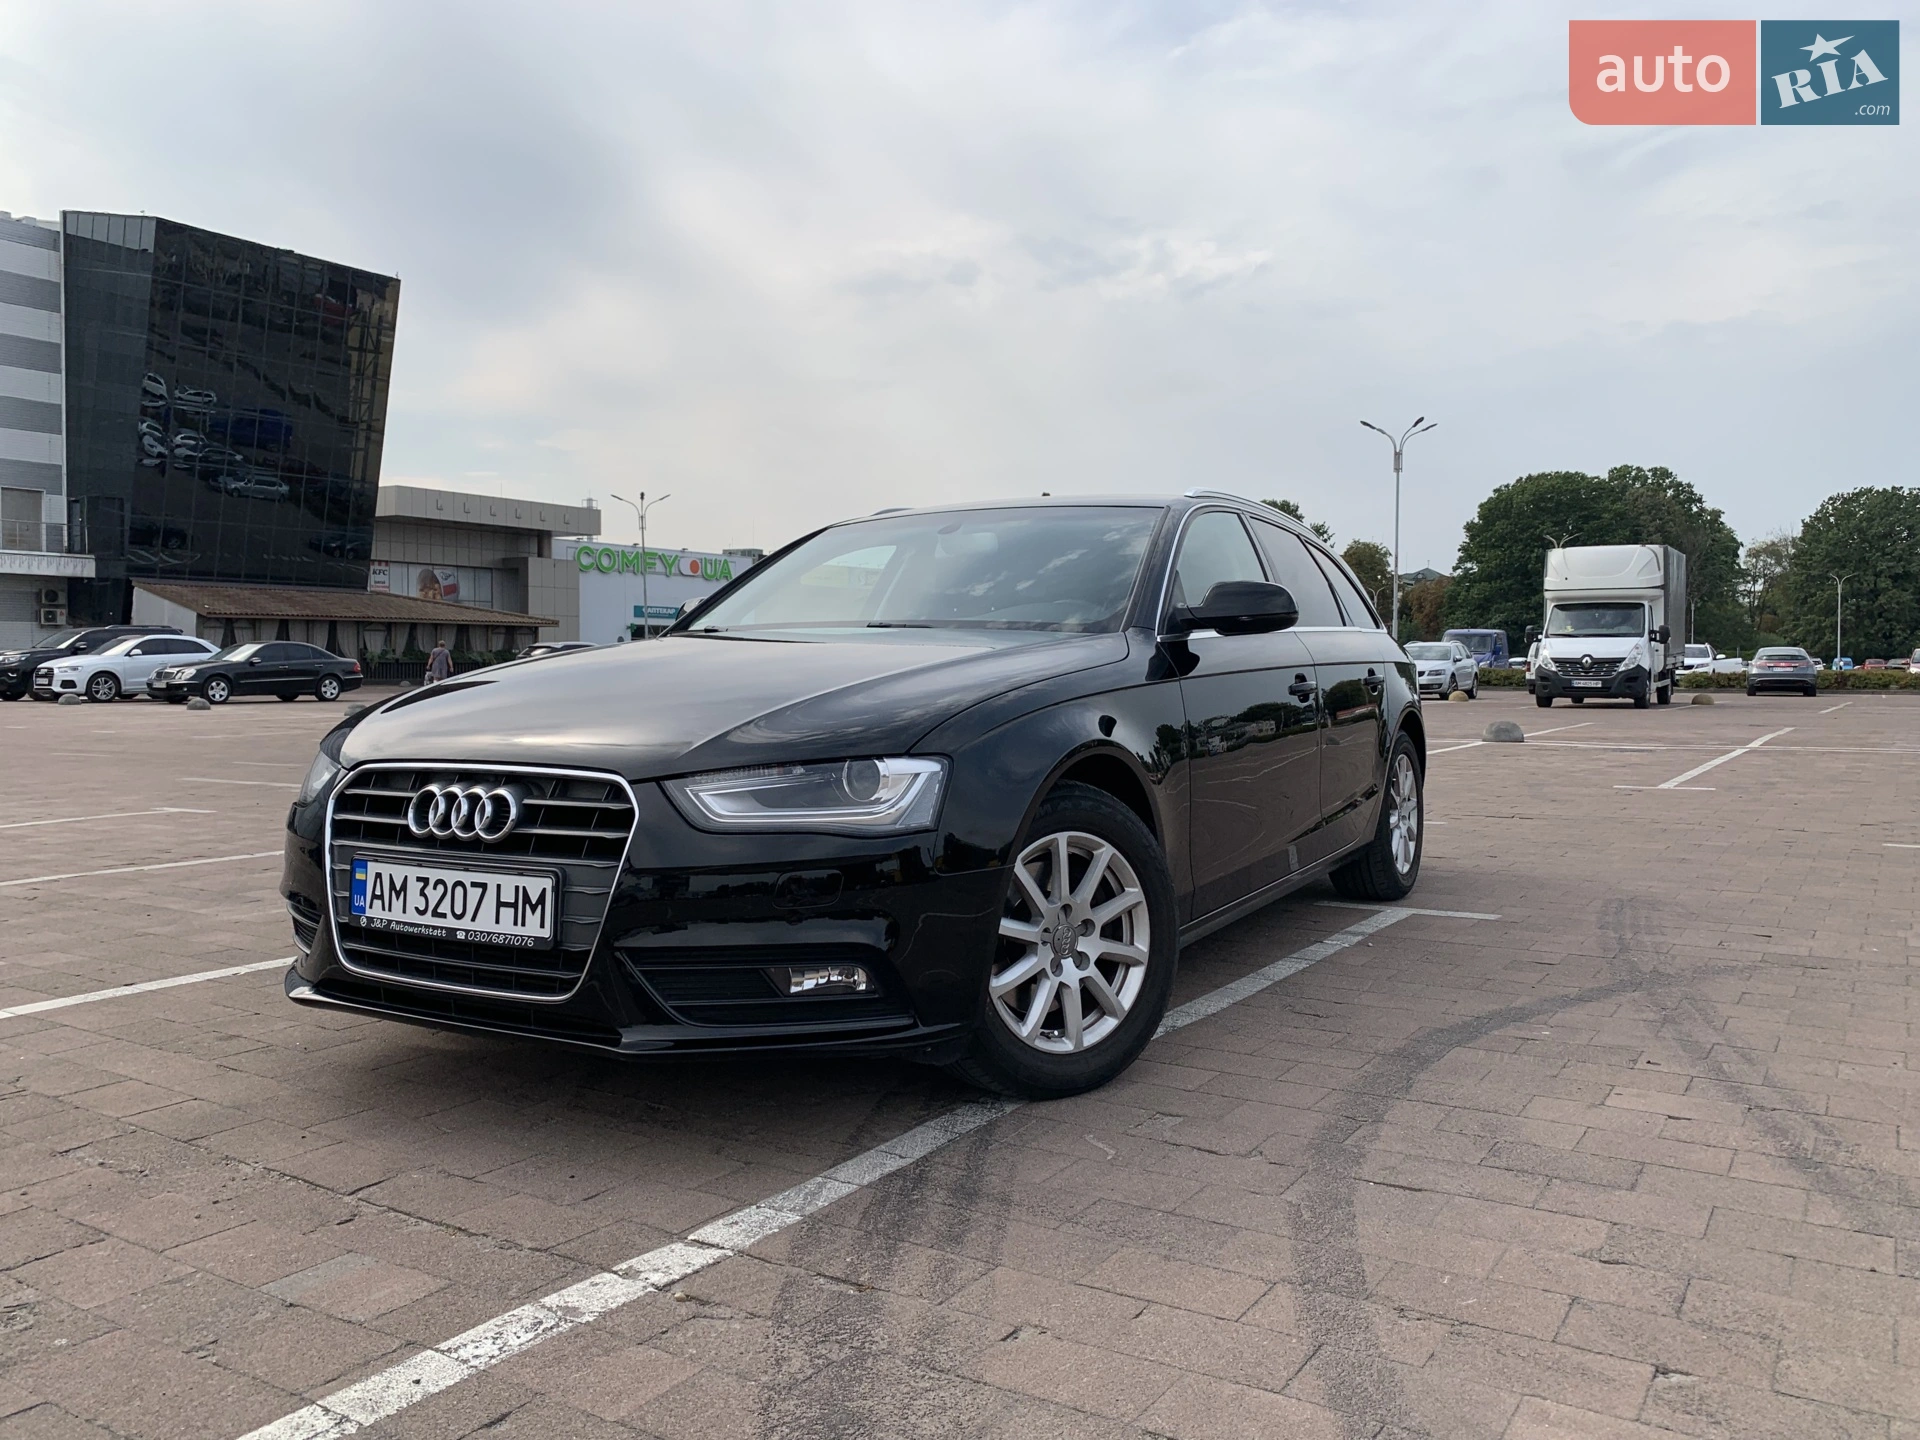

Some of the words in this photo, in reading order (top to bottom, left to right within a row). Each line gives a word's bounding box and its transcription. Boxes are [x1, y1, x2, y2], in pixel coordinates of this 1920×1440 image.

[372, 568, 388, 576] KFC
[576, 545, 679, 577] COMFY
[702, 557, 733, 581] UA
[354, 894, 365, 908] UA
[368, 872, 409, 914] AM
[413, 876, 488, 922] 3207
[495, 884, 547, 929] HM
[370, 918, 388, 928] J&P
[389, 922, 447, 937] Autowerkstatt
[467, 931, 535, 947] 030/6871076
